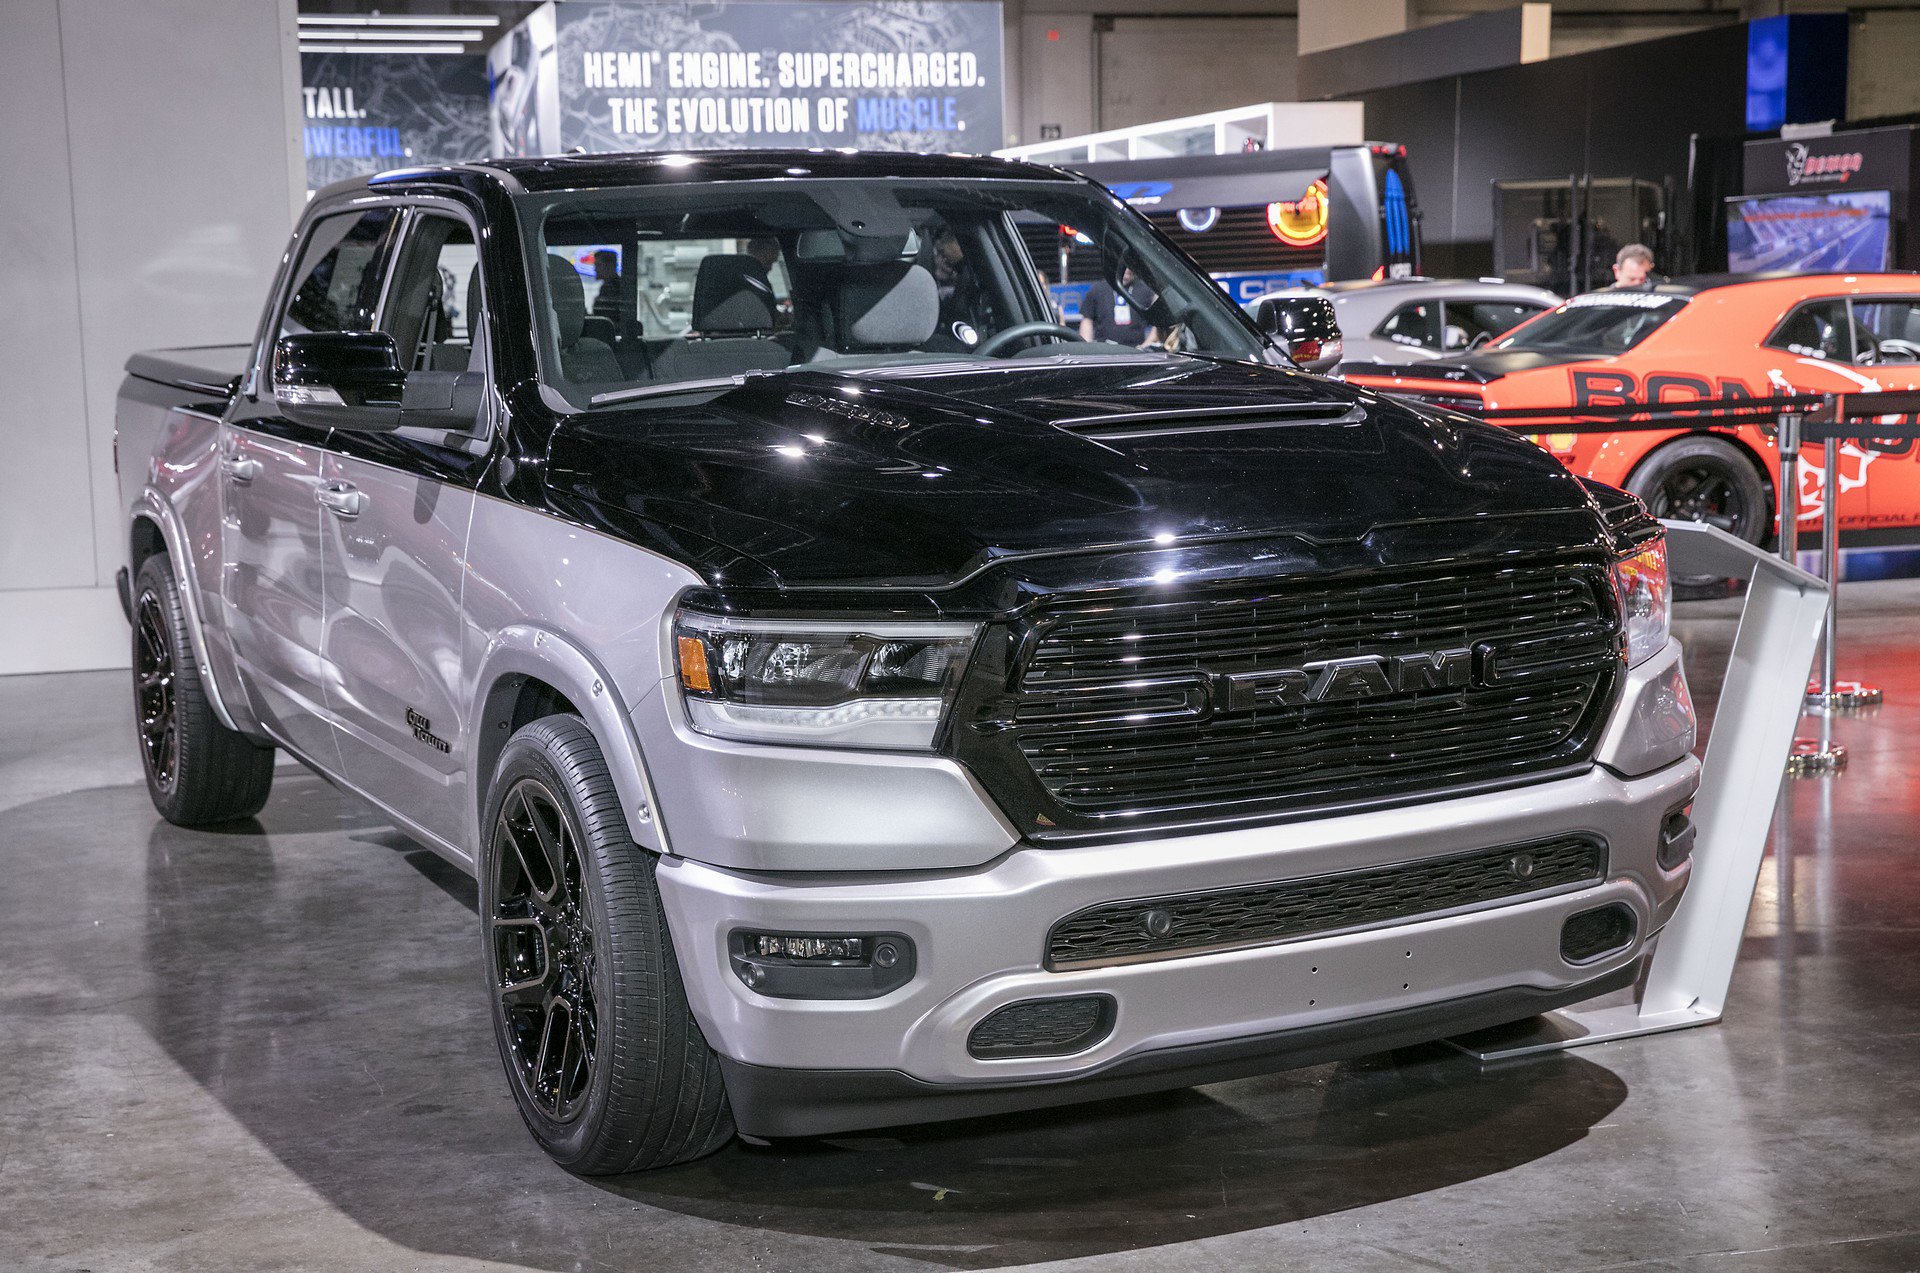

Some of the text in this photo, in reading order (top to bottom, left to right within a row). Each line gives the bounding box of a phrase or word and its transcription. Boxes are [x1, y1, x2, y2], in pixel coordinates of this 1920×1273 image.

[669, 52, 771, 89] ENGINE.
[778, 52, 986, 89] SUPERCHARGED.
[302, 87, 367, 119] TALL.
[607, 96, 967, 134] THE EVOLUTION OF MUSCLE.
[1226, 648, 1472, 712] RAM
